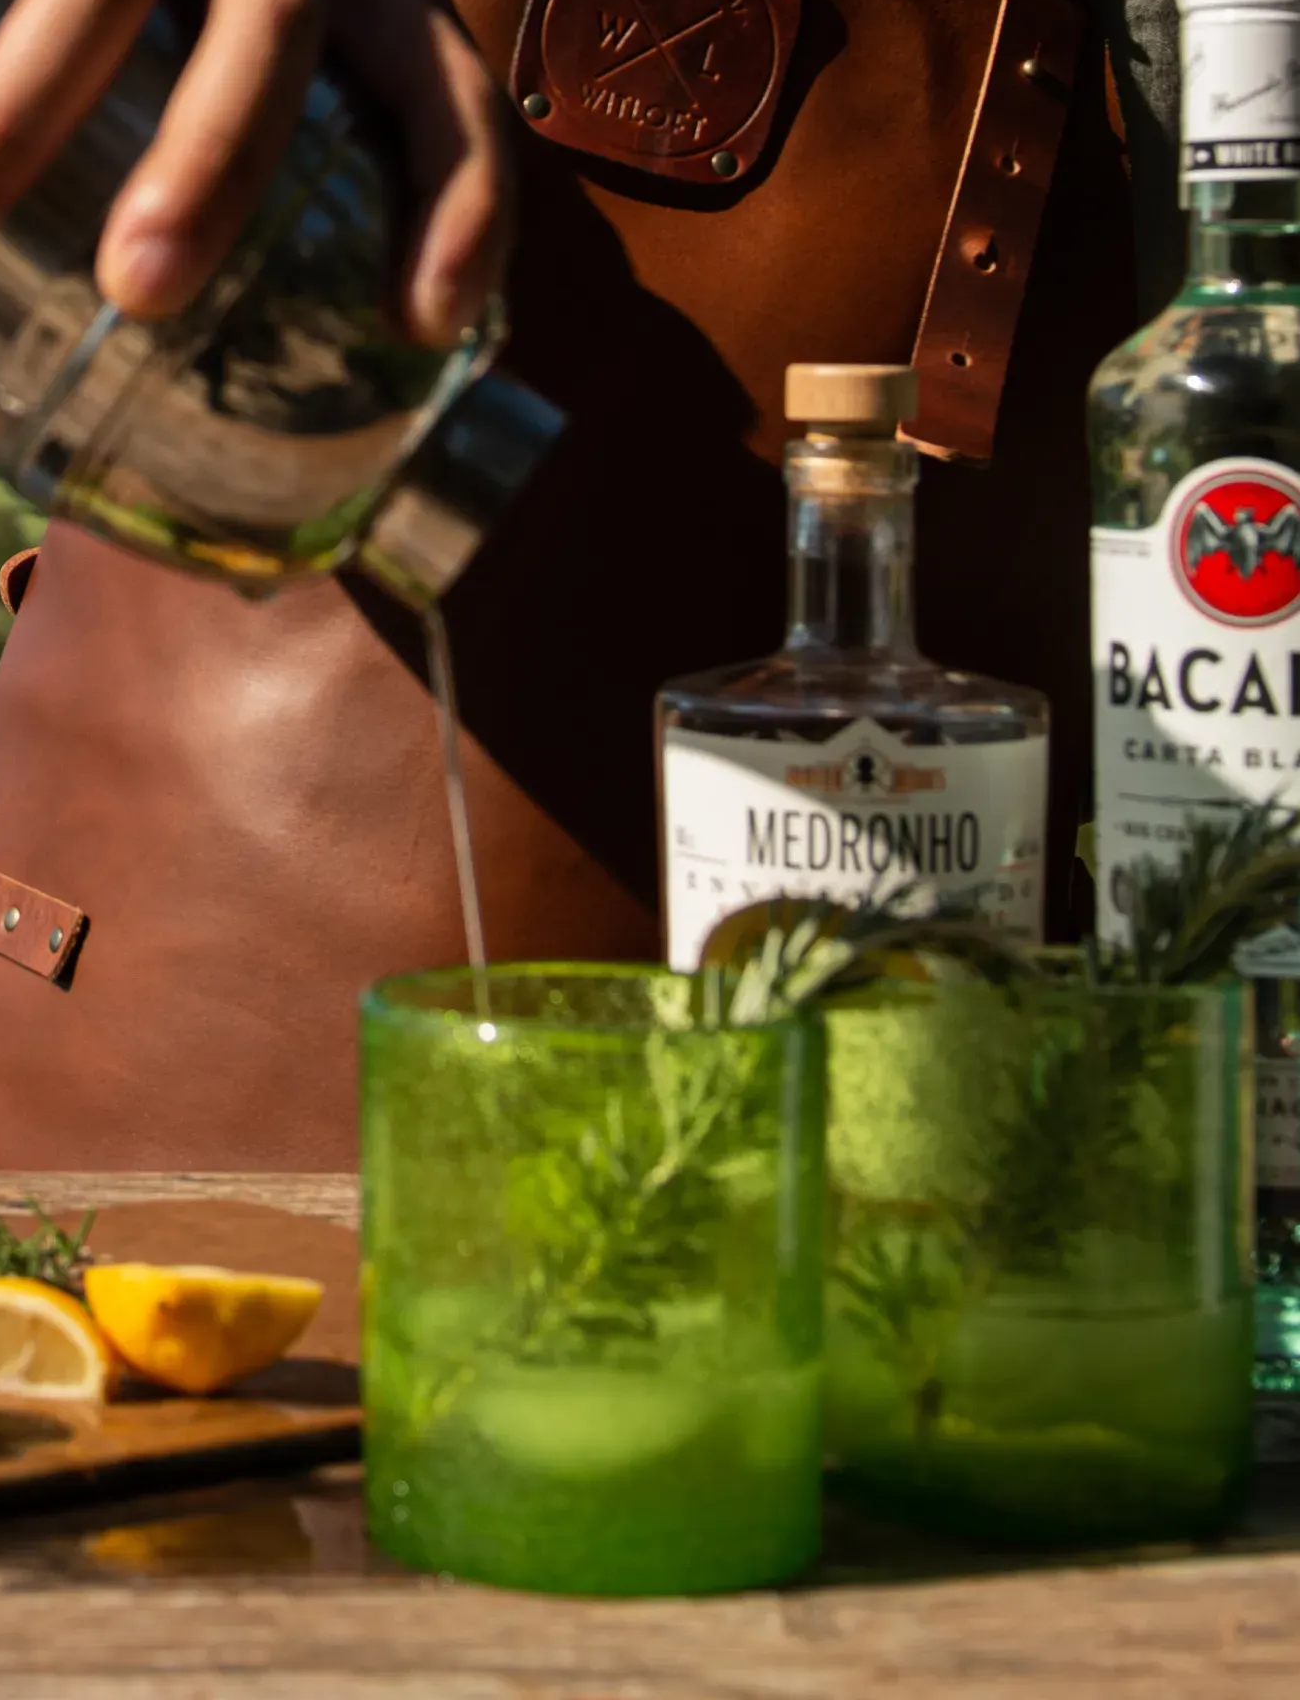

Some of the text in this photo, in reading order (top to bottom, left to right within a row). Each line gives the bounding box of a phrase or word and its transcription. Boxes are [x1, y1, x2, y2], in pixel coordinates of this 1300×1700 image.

[598, 9, 640, 52] W
[699, 42, 722, 84] L
[1109, 640, 1300, 718] BACA
[1124, 736, 1225, 770] CARTA
[745, 806, 982, 874] MEDRONHO
